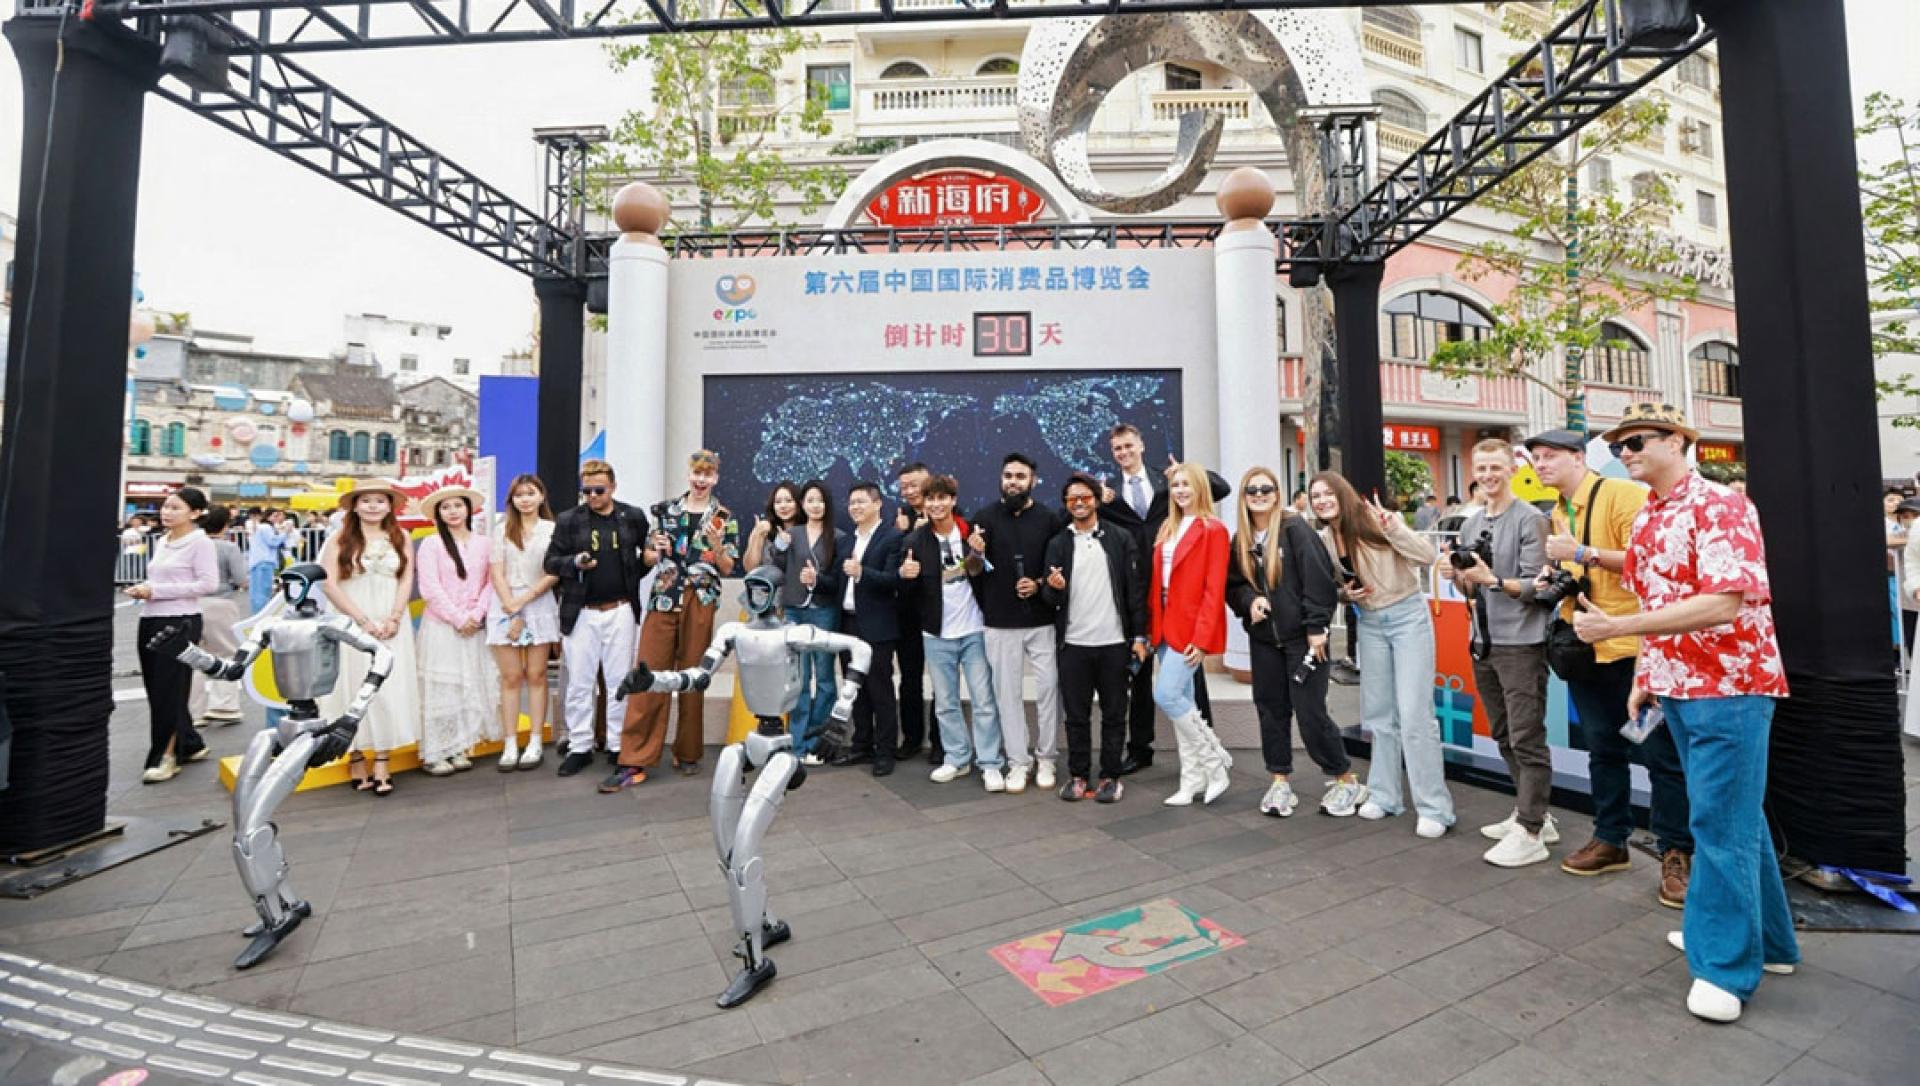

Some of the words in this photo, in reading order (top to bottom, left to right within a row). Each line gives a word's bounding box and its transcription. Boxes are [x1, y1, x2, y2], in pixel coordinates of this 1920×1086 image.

[897, 184, 1009, 216] 新海府
[804, 265, 1151, 296] 第六届中国国际消费品博览会
[884, 322, 966, 349] 倒计时
[976, 315, 1028, 354] 30
[1038, 322, 1064, 347] 天
